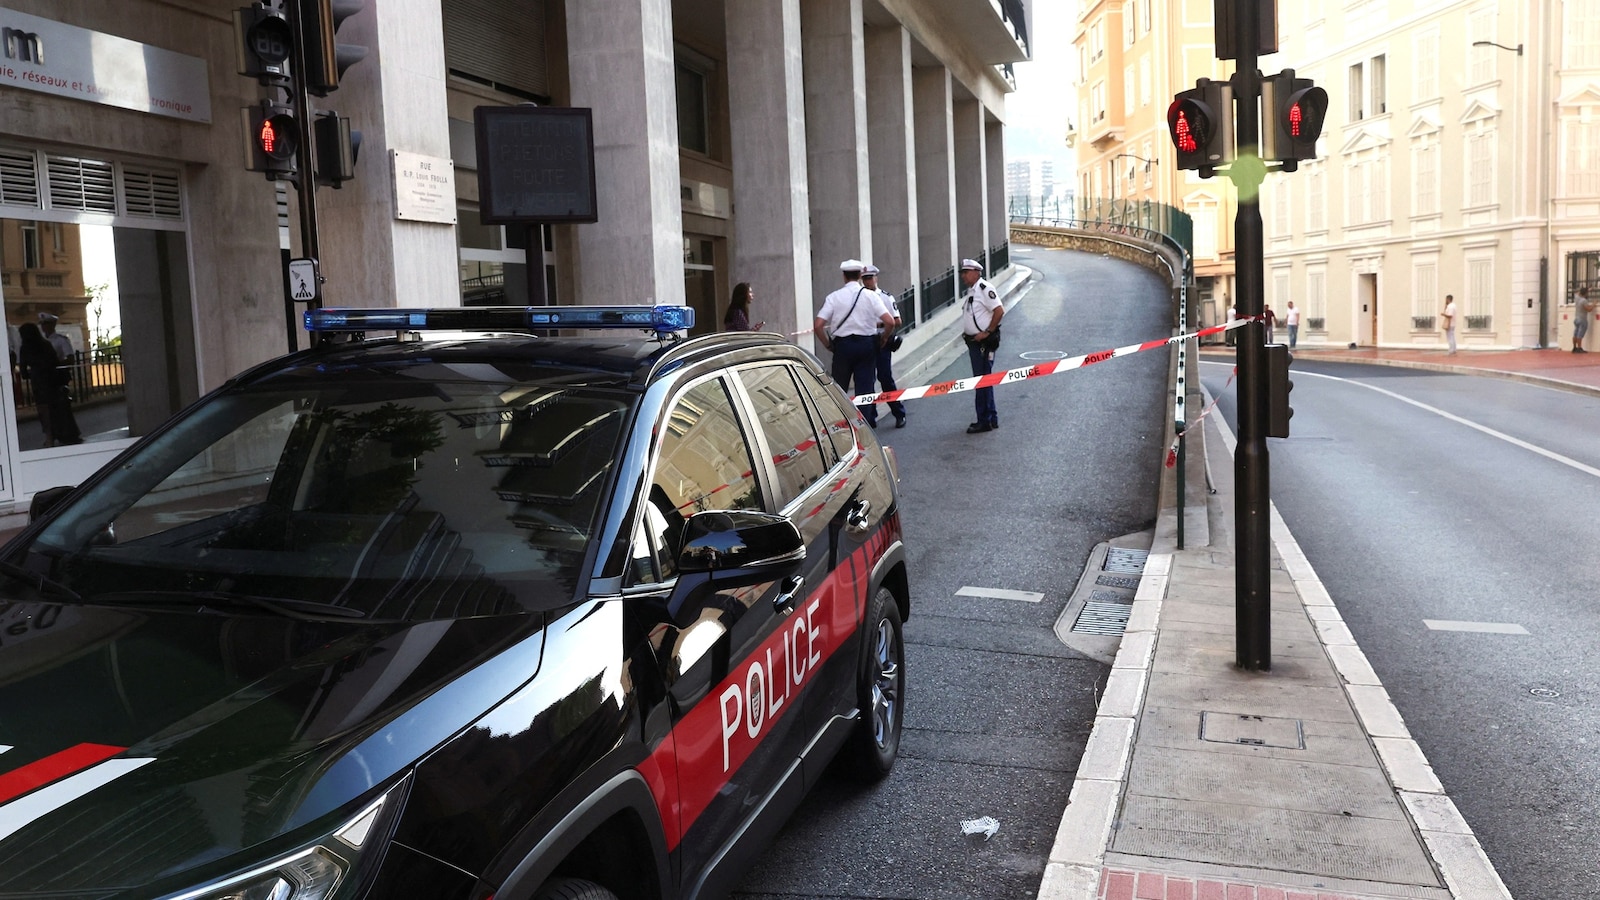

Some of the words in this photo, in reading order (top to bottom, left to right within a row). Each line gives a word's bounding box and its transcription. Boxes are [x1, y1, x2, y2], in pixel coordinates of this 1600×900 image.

[22, 69, 68, 89] réseaux
[71, 79, 83, 92] et
[420, 161, 432, 171] RUE
[1008, 366, 1041, 380] POLICE
[933, 381, 965, 394] POLICE
[861, 393, 891, 403] POLICE
[719, 598, 821, 773] POLICE
